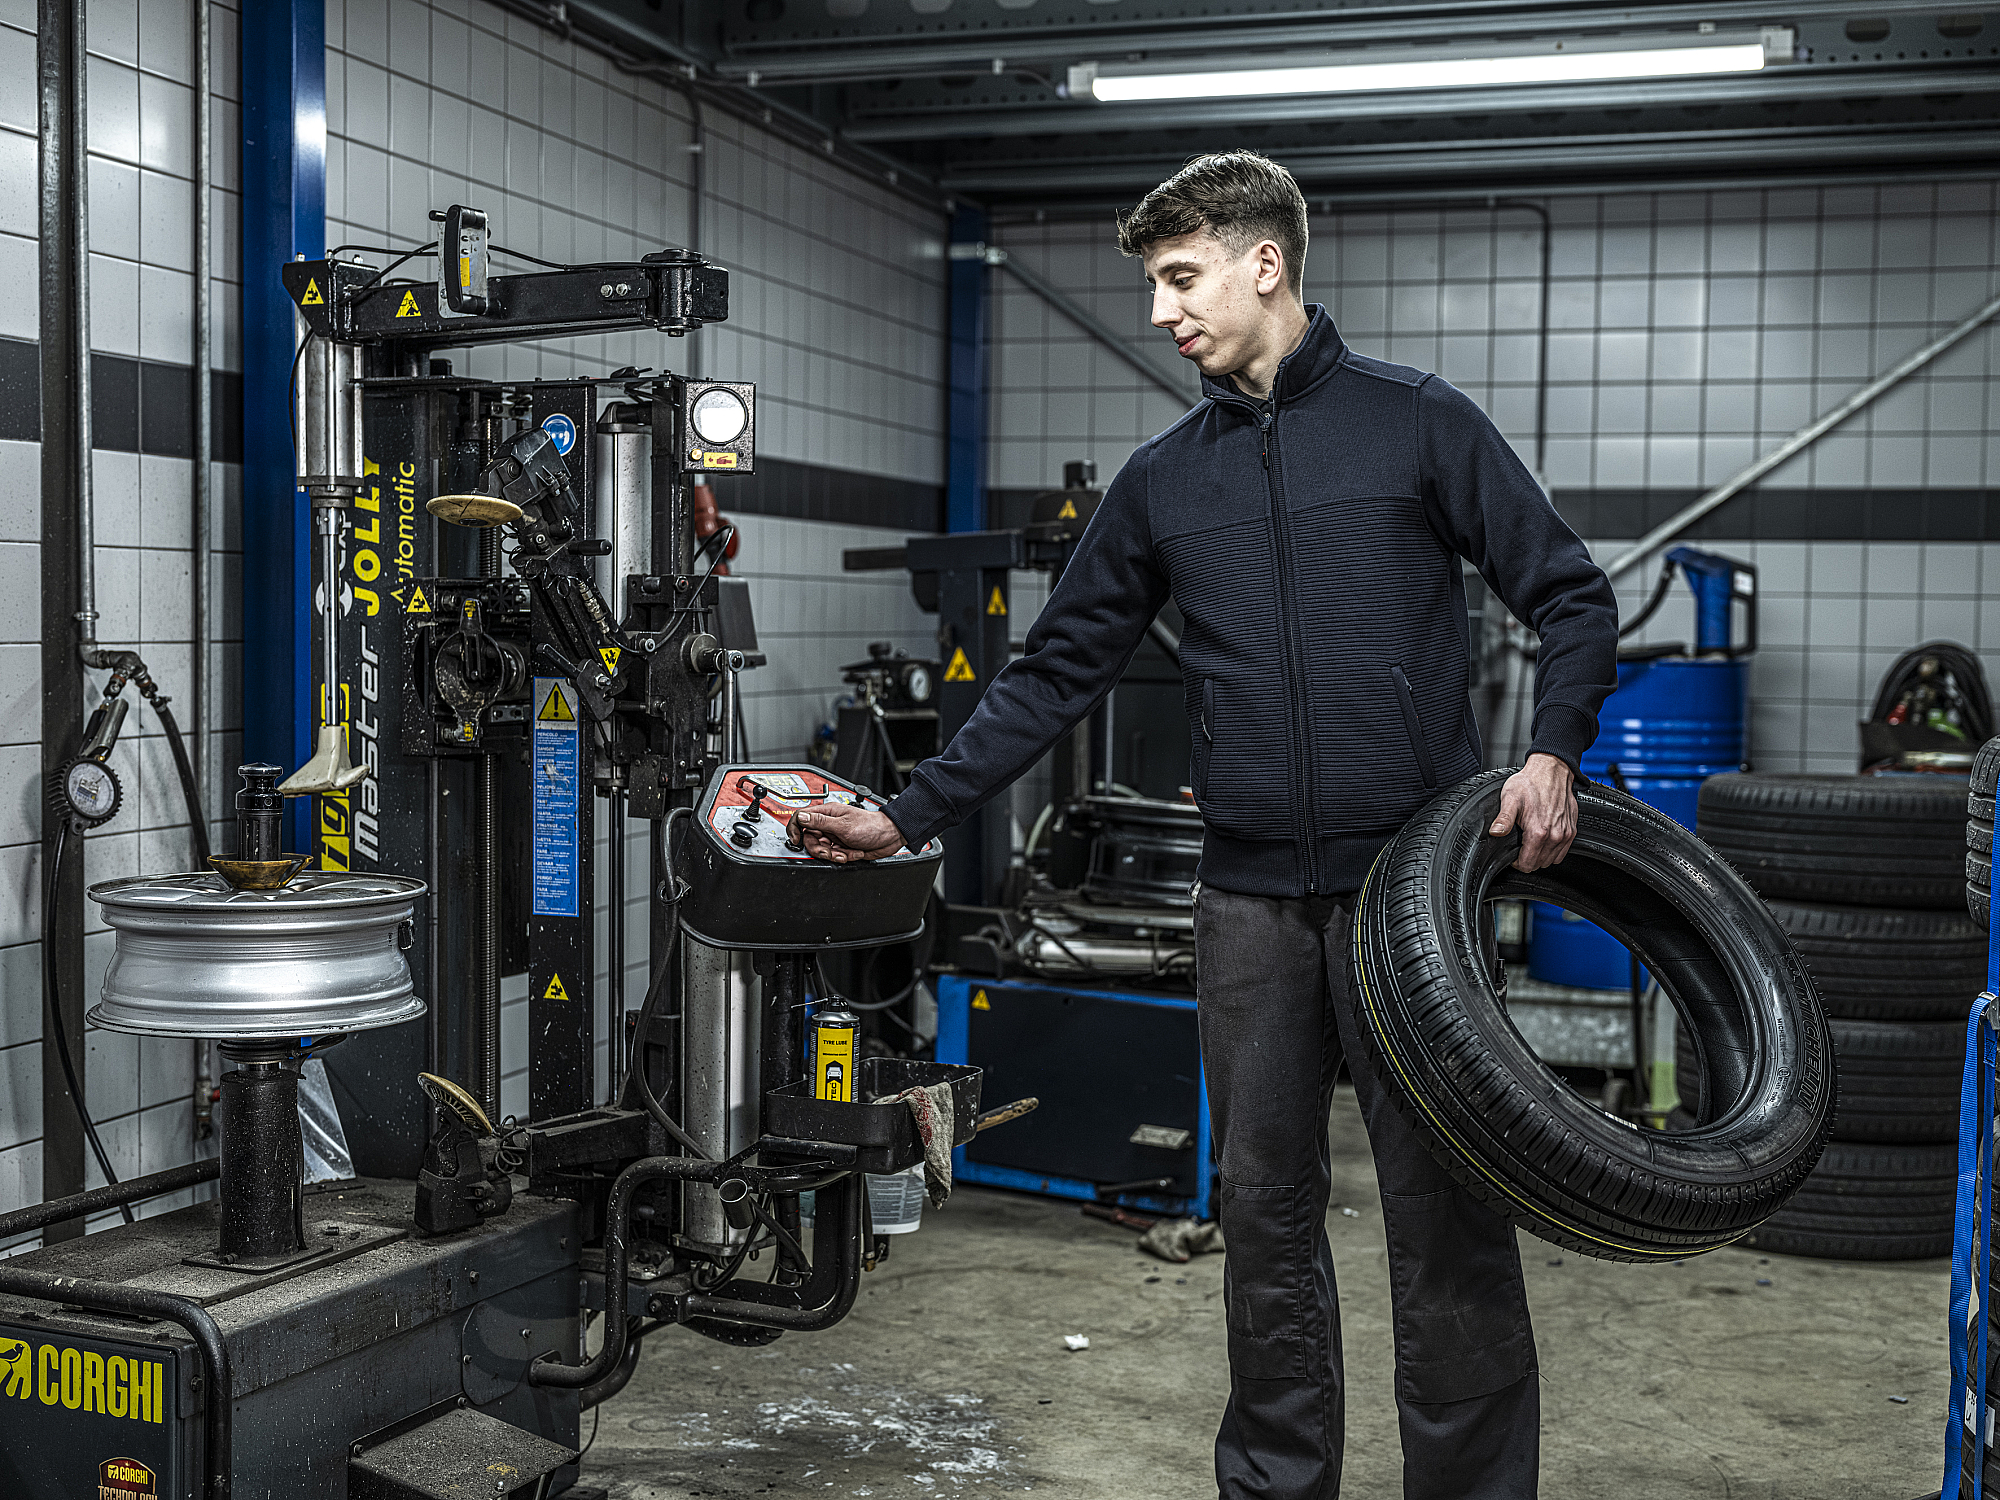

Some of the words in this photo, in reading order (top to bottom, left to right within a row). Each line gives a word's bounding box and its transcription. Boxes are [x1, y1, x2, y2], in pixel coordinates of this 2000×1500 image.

[353, 455, 381, 617] JOLLY
[354, 623, 379, 863] Master
[1445, 825, 1476, 948] MICHELIN
[1794, 984, 1822, 1110] MICHELIN
[38, 1343, 163, 1424] CORGHI
[119, 1466, 148, 1485] CORGHI
